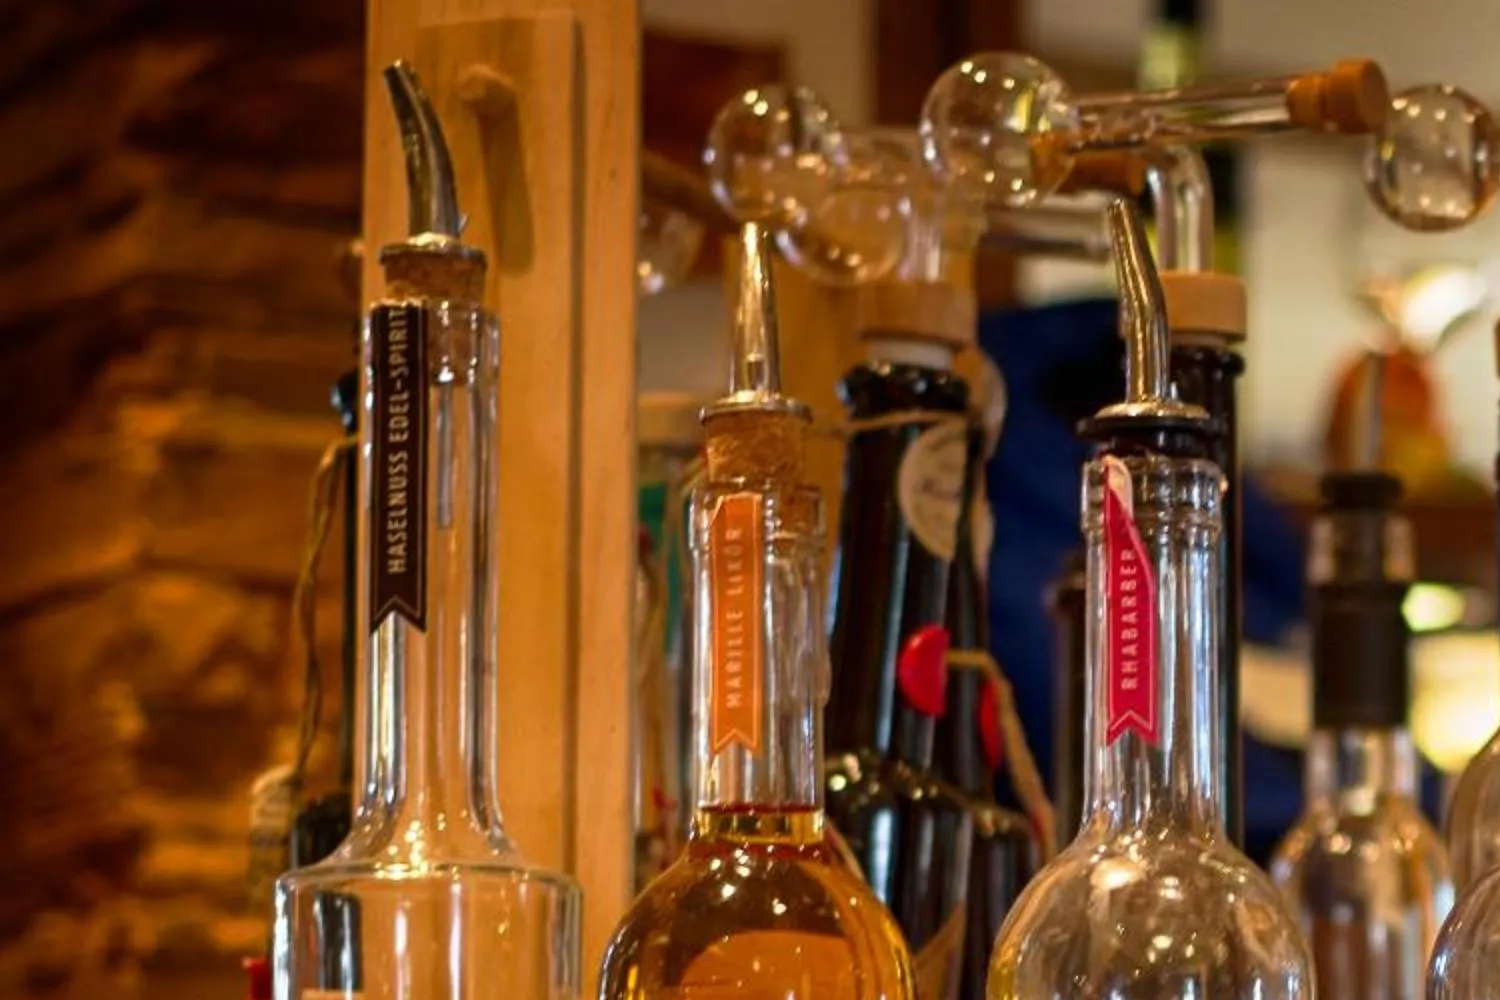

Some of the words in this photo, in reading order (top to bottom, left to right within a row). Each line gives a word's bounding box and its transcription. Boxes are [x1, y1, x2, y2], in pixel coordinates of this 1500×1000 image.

[387, 450, 409, 575] HASELNUSS
[725, 610, 744, 709] MARILLE
[1119, 548, 1138, 691] RHABARBER
